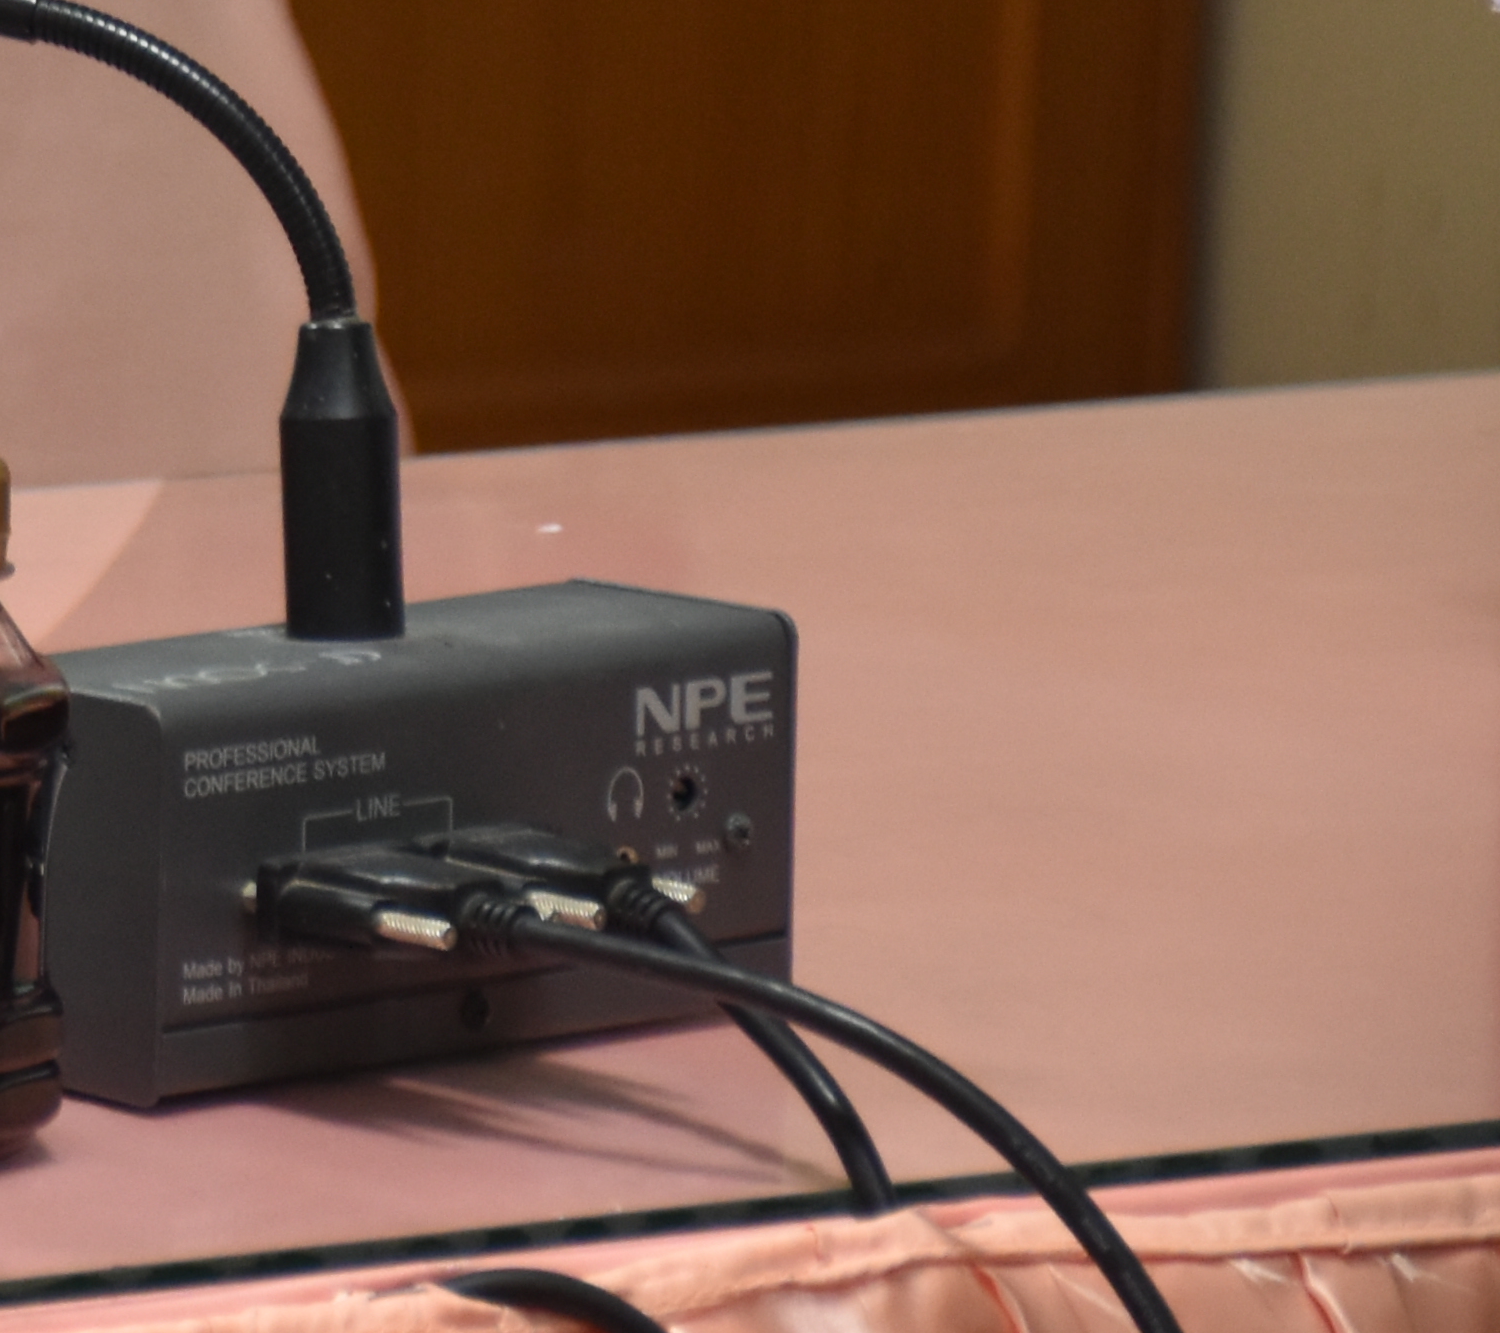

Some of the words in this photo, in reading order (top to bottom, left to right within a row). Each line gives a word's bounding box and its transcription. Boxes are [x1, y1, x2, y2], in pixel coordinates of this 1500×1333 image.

[635, 671, 773, 736] NPE
[183, 735, 321, 771] PROFESSIONAL
[634, 724, 775, 757] RESEARCH
[182, 762, 307, 799] CONFERENCE
[312, 752, 387, 781] SYSTEM
[356, 794, 402, 822] LINE
[182, 960, 223, 980] Made
[227, 956, 244, 976] by
[182, 986, 224, 1005] Made
